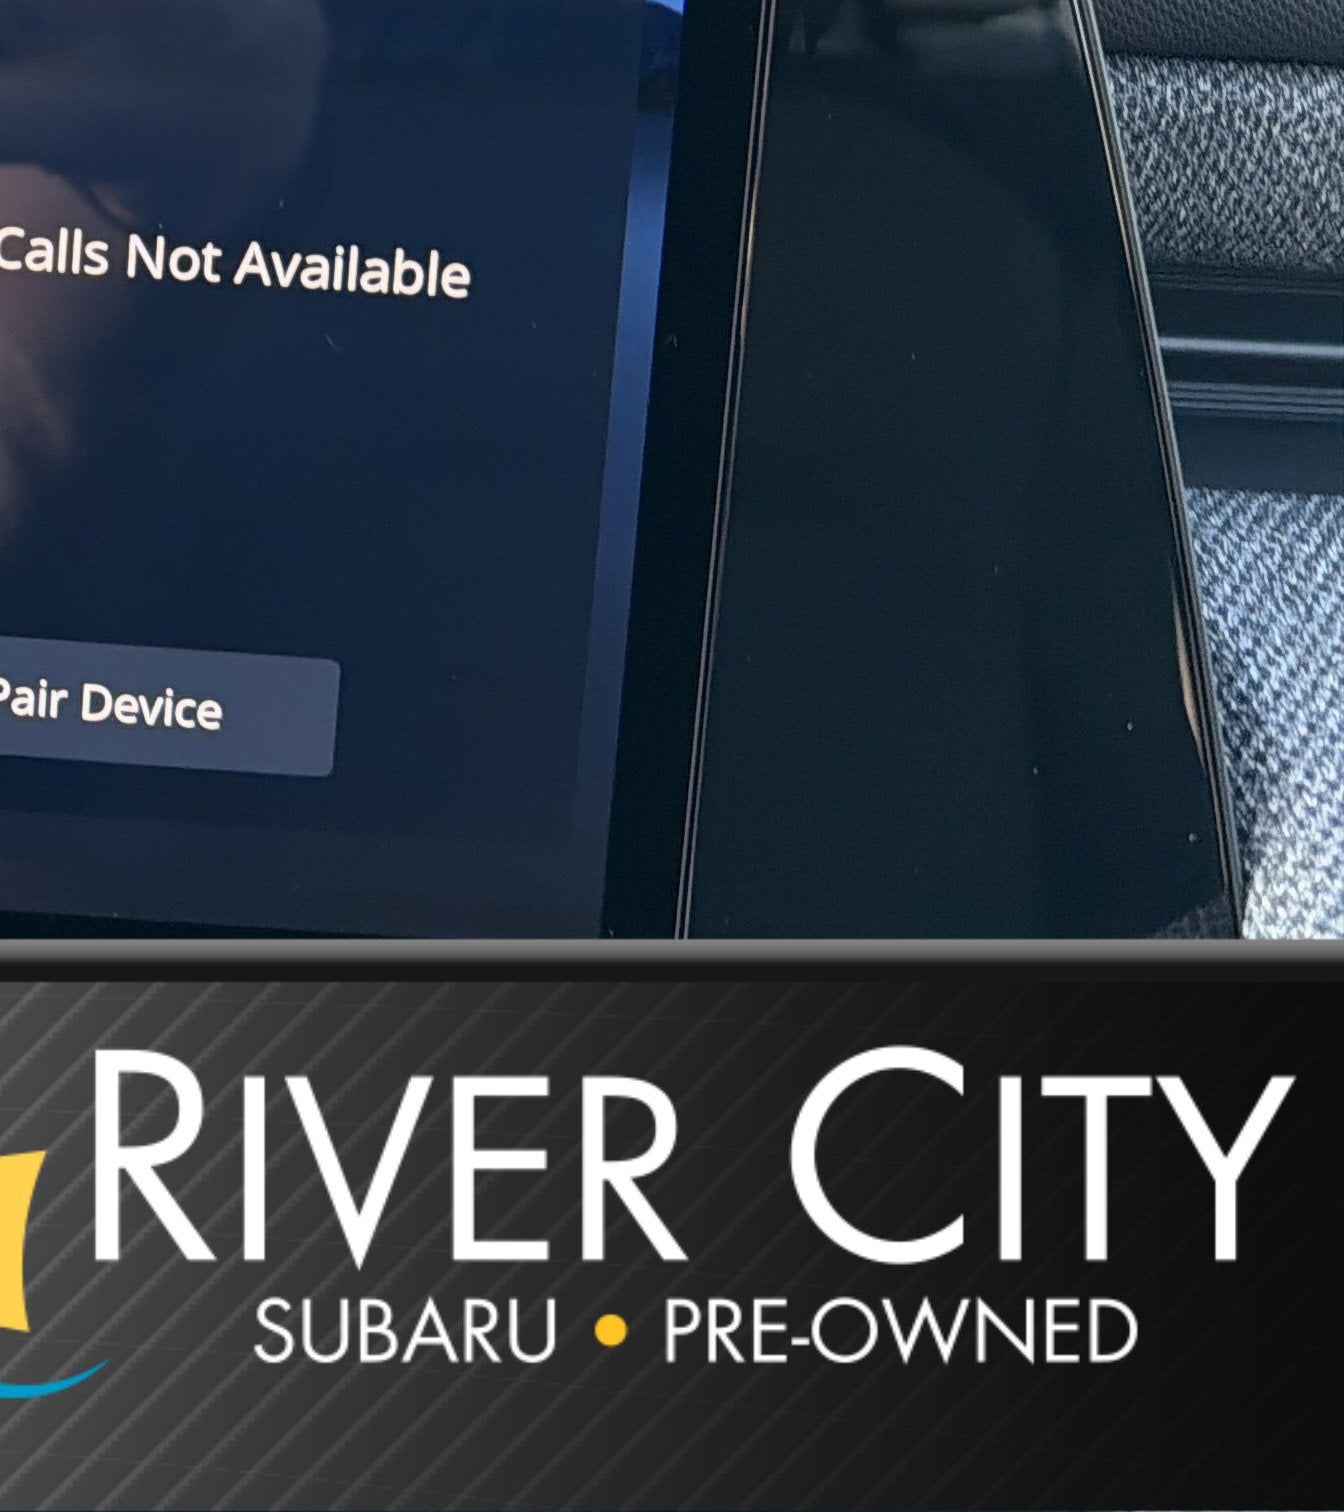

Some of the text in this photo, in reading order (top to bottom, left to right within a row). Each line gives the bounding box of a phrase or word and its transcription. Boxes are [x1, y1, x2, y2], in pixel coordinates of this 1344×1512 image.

[126, 233, 223, 283] Not
[233, 240, 471, 299] Available
[81, 682, 223, 731] Device
